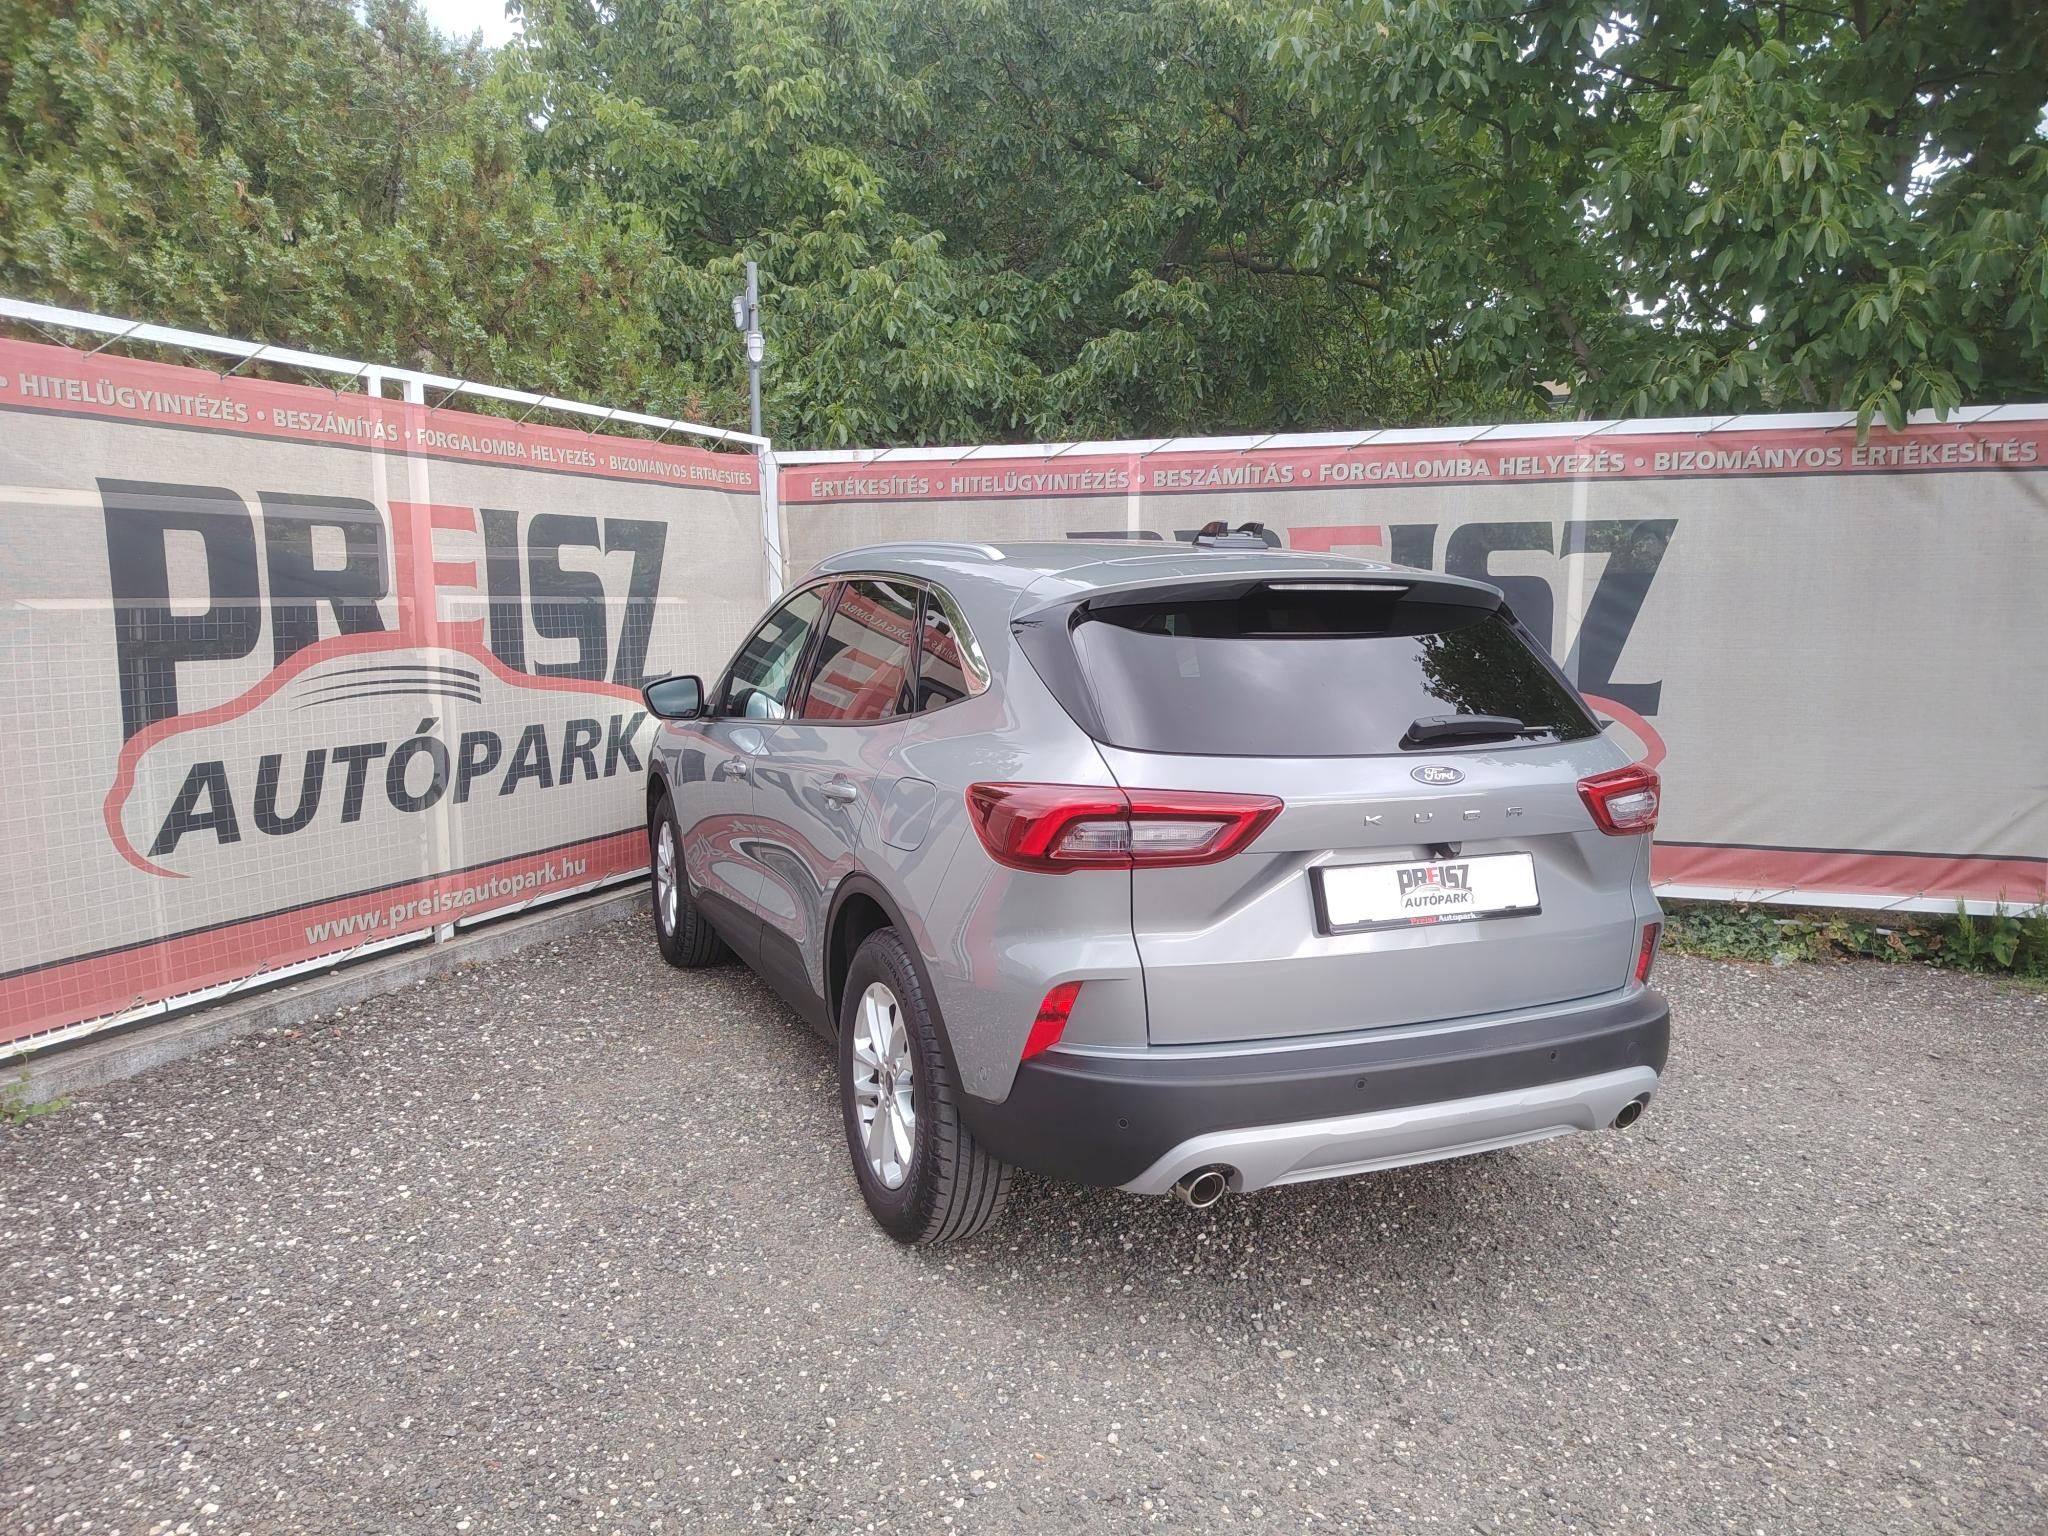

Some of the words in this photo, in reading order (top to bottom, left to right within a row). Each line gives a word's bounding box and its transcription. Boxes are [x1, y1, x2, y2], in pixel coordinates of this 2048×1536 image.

[19, 373, 249, 423] HITELÜGYINTÉZÉS
[272, 408, 398, 441] BESZÁMÍTÁS
[416, 428, 527, 458] FORGALOMBA
[531, 443, 596, 467] HELYEZÉS
[609, 455, 687, 478] BIZOMÁNYOS
[690, 463, 752, 485] ÉRTÉKESÍTÉS
[811, 474, 929, 497] ÉRTÉKESÍTÉS
[951, 468, 1129, 493] HITELÜGYINTÉZÉS
[1153, 462, 1294, 488] BESZÁMÍTÁS
[1318, 457, 1491, 482] FORGALOMBA
[1498, 449, 1626, 475] HELYEZÉS
[1654, 445, 1842, 471] BIZOMÁNYOS
[1851, 438, 2038, 467] ÉRTÉKESÍTÉS
[95, 477, 672, 745] PREISZ
[147, 710, 648, 856] AUTÓPARK
[1424, 767, 1456, 781] Ford
[1363, 806, 1523, 827] KUGA
[305, 856, 586, 944] www.preiszautopark.hu
[1396, 864, 1472, 895] PREISZ
[1404, 892, 1469, 908] AUTÓPARK
